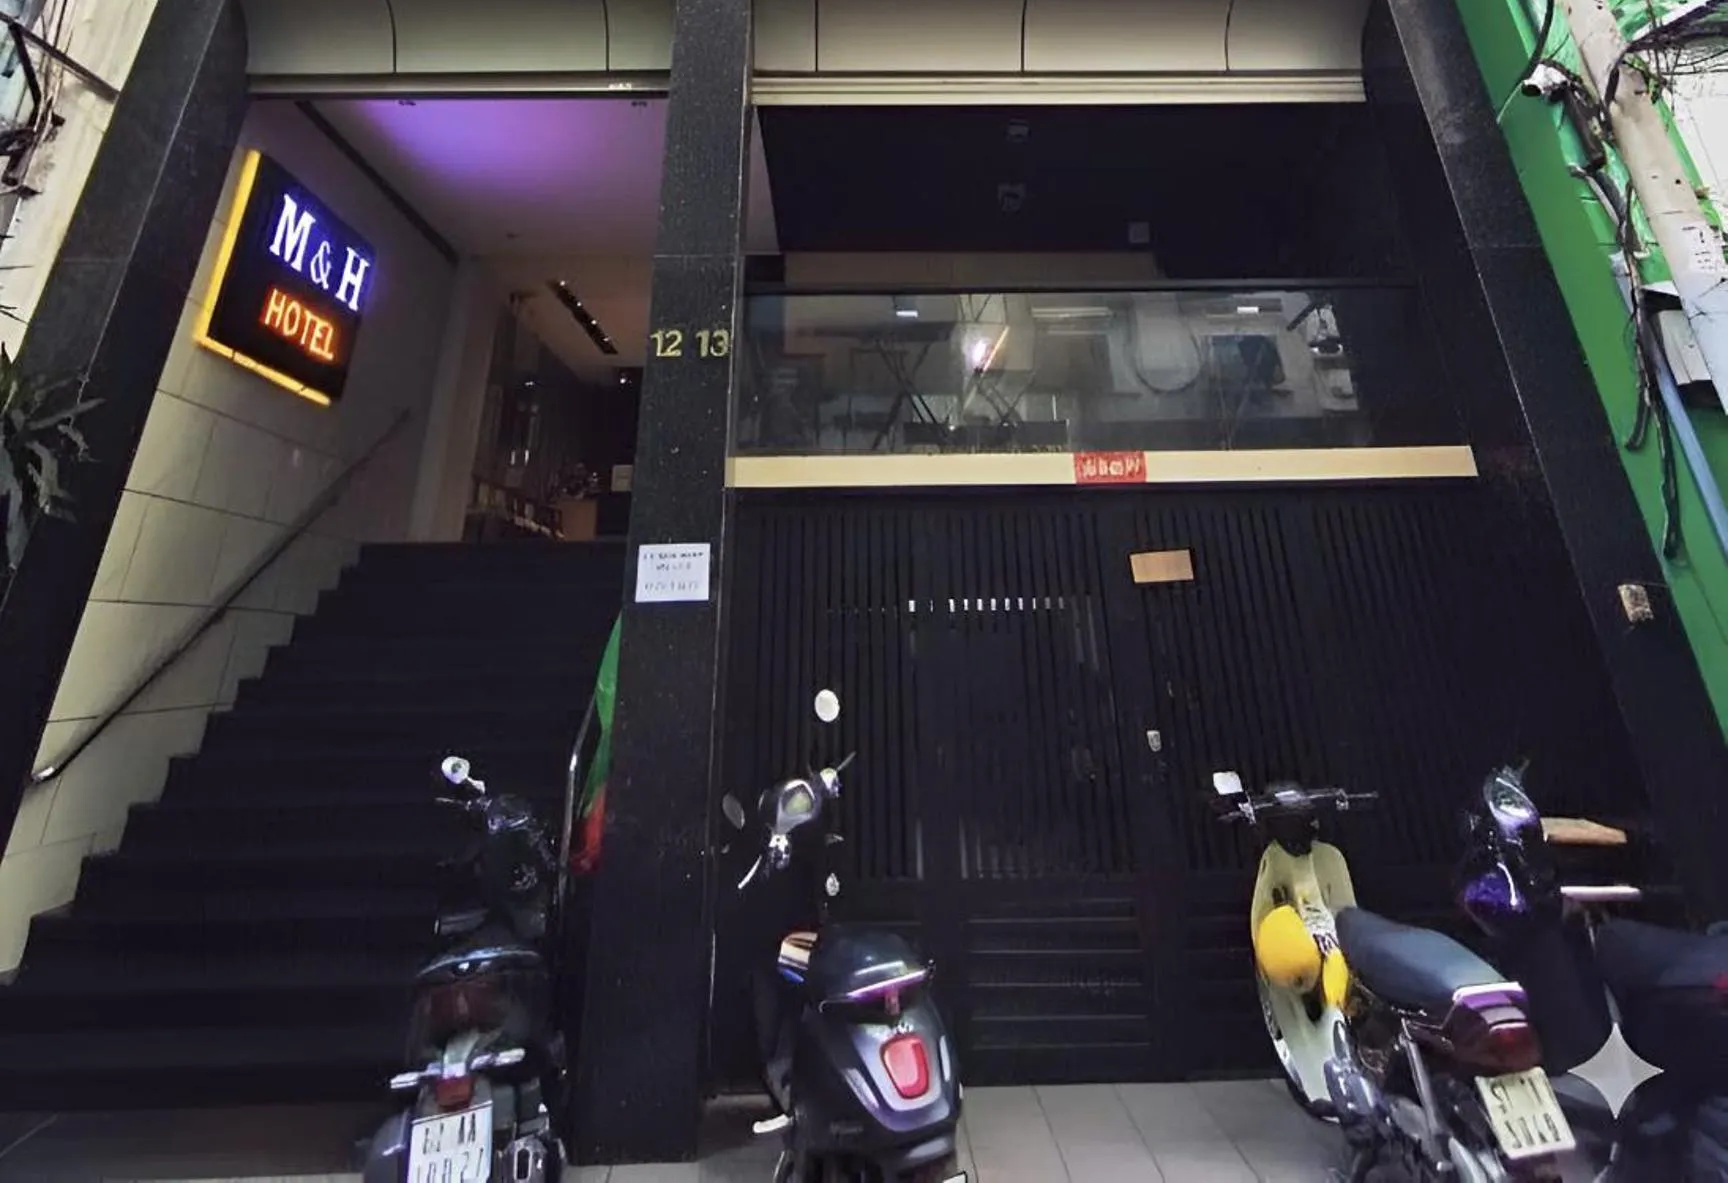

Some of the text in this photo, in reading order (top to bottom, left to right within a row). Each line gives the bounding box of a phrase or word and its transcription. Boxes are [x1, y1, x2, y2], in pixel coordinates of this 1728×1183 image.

[264, 288, 334, 360] HOTEL
[651, 329, 729, 357] 12 13
